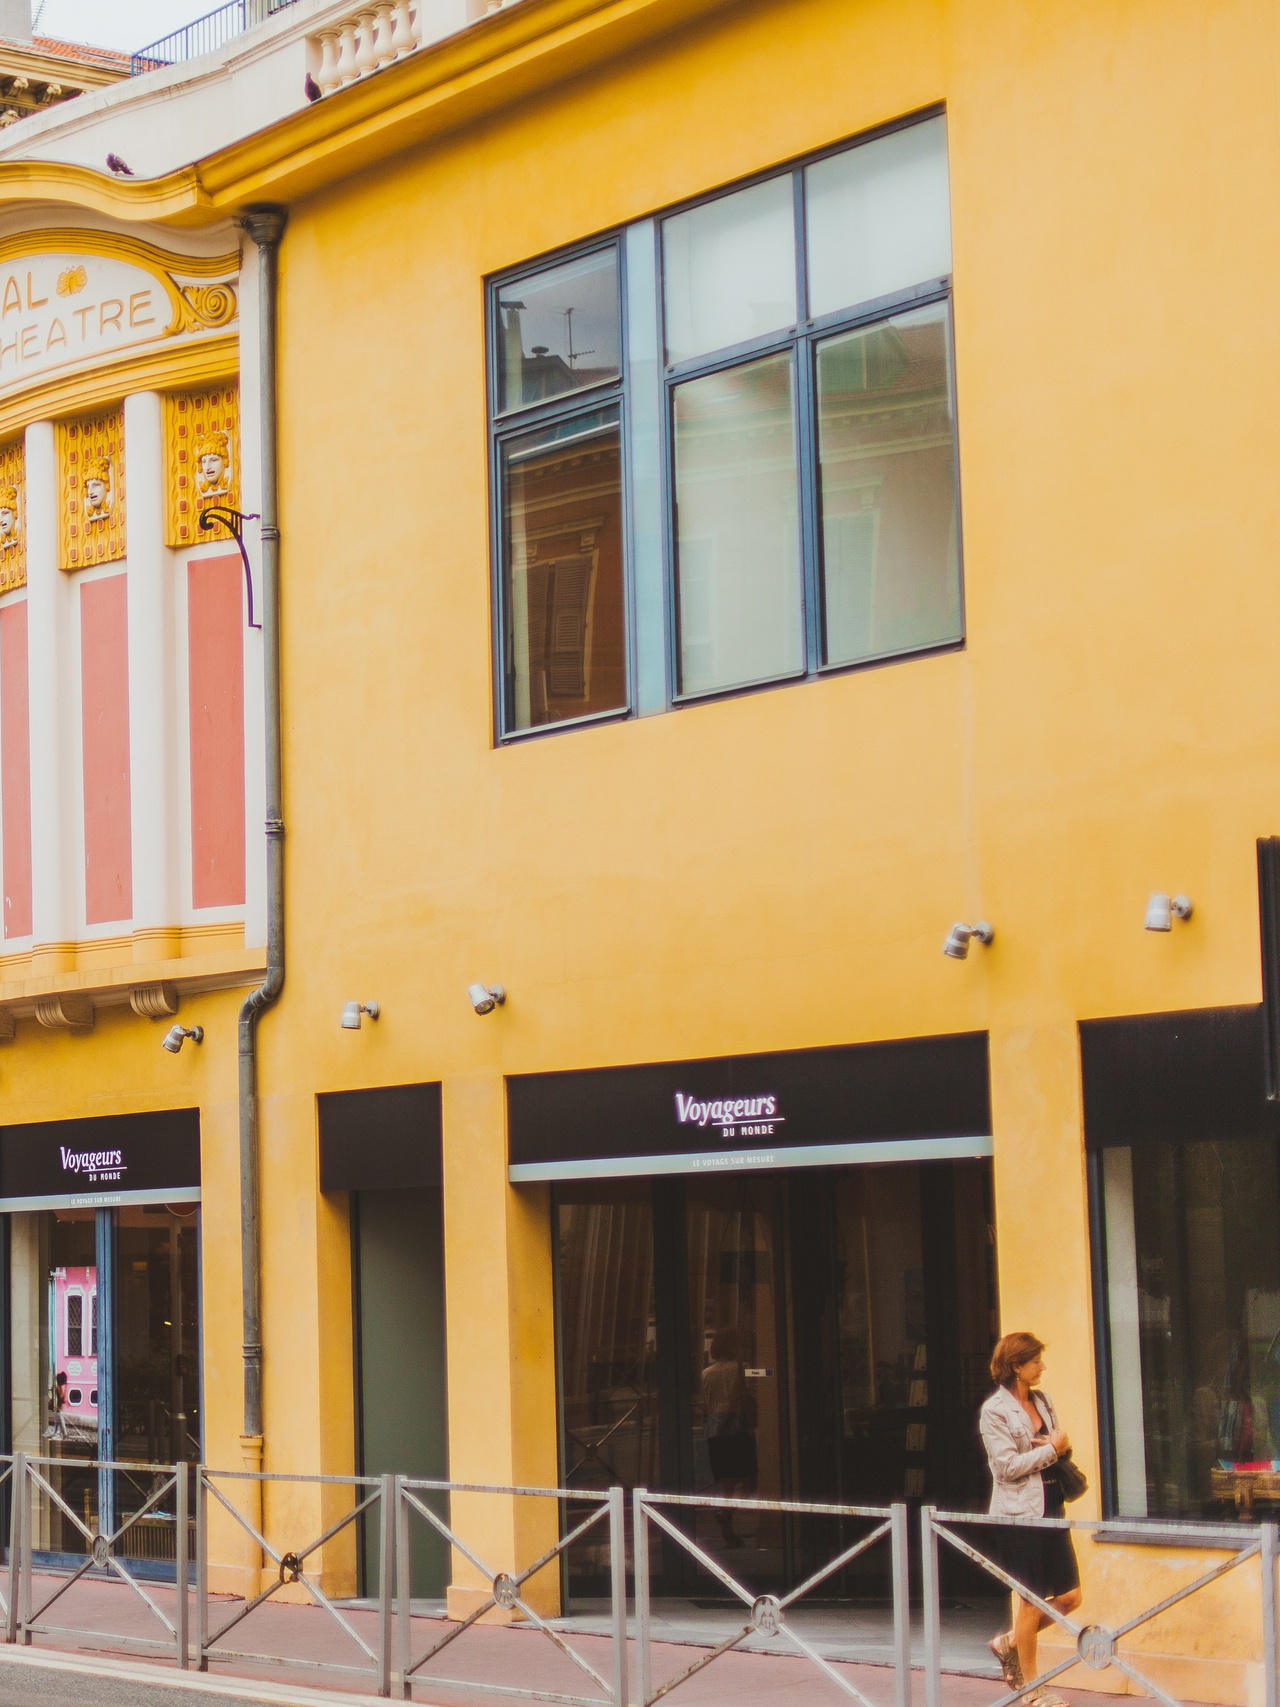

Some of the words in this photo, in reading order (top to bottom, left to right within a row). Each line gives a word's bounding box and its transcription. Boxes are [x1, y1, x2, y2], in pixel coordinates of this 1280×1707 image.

[676, 1093, 776, 1127] Voyageurs
[723, 1128, 735, 1137] DU
[741, 1124, 774, 1136] MONDE
[60, 1146, 122, 1173] Voyageurs
[703, 1157, 729, 1166] VOYAGE
[731, 1156, 745, 1165] SUR
[746, 1155, 775, 1164] MESURE
[89, 1173, 97, 1182] DU
[100, 1171, 121, 1181] MONDE
[77, 1197, 93, 1205] VOYAGE
[94, 1196, 103, 1204] SUR
